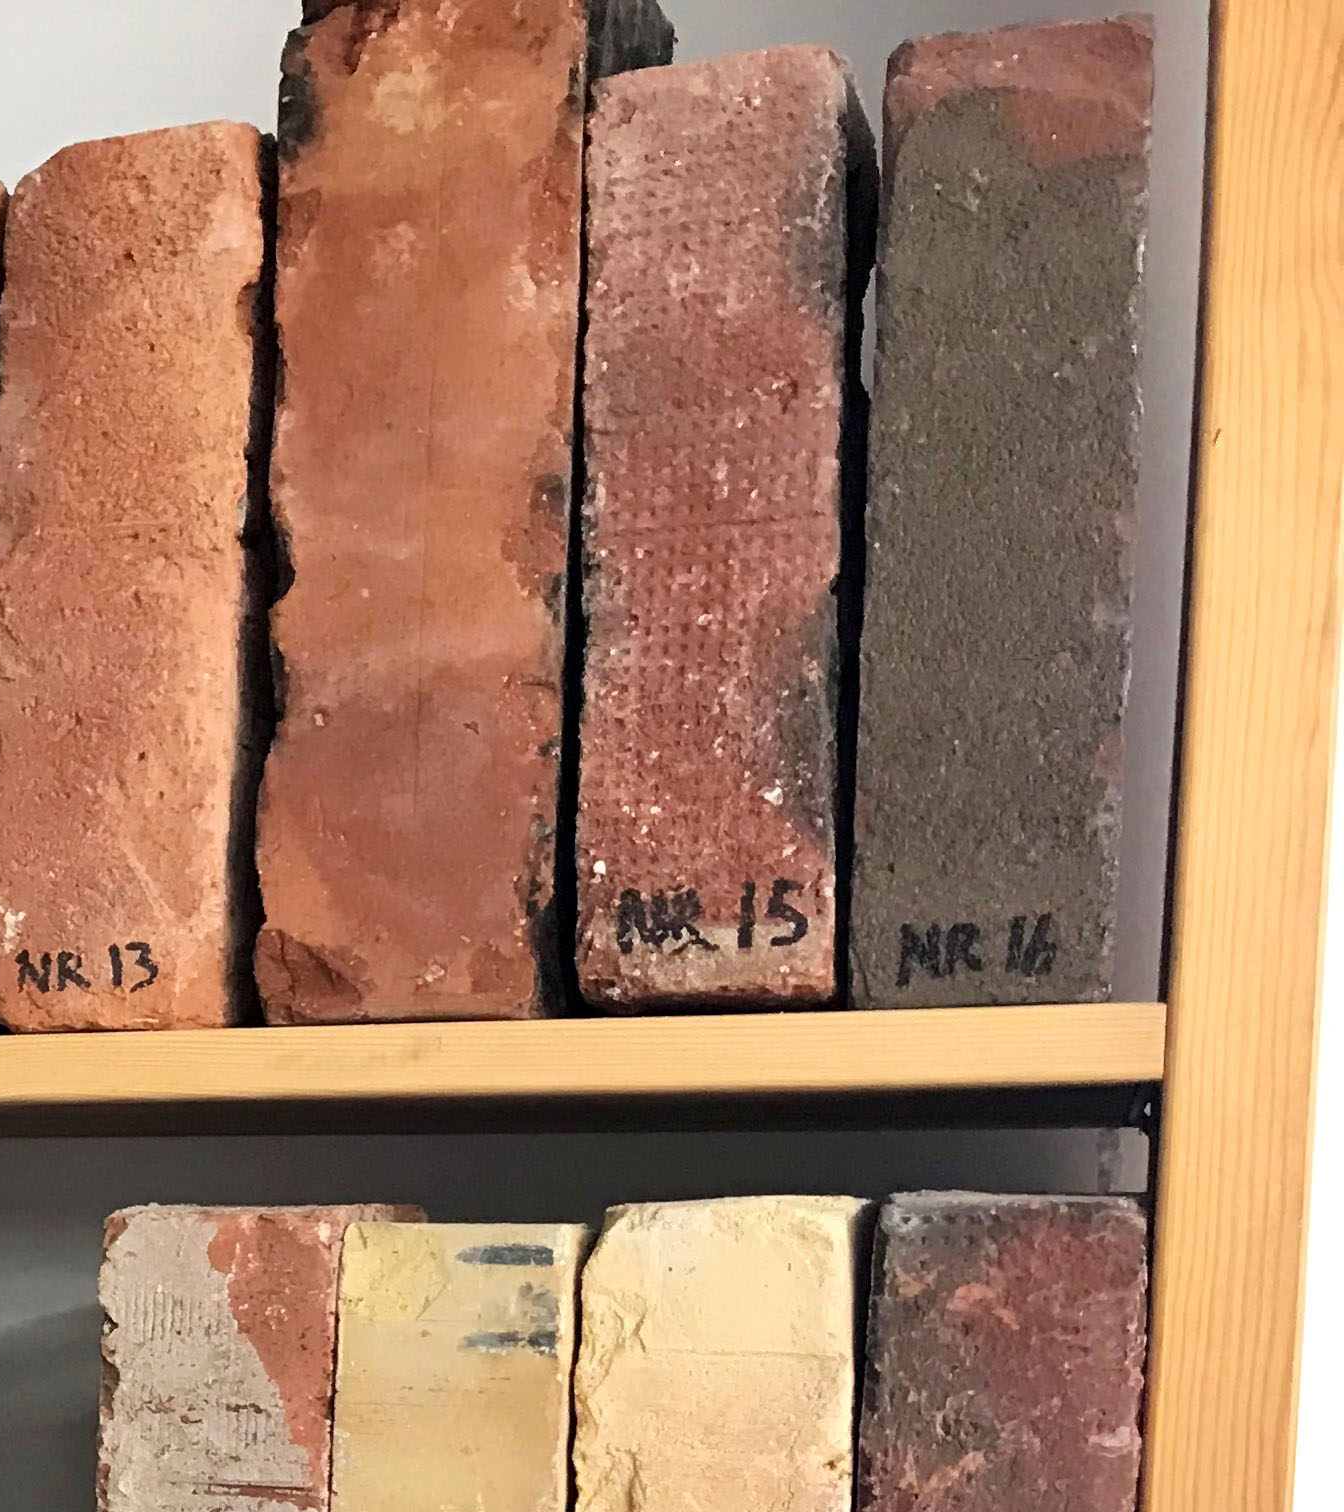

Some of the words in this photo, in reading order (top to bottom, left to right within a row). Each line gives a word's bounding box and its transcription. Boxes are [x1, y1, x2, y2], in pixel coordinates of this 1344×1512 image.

[617, 887, 720, 955] NR
[737, 877, 809, 949] 15
[15, 948, 92, 994] NR
[108, 941, 159, 994] 13
[896, 922, 983, 988] NR
